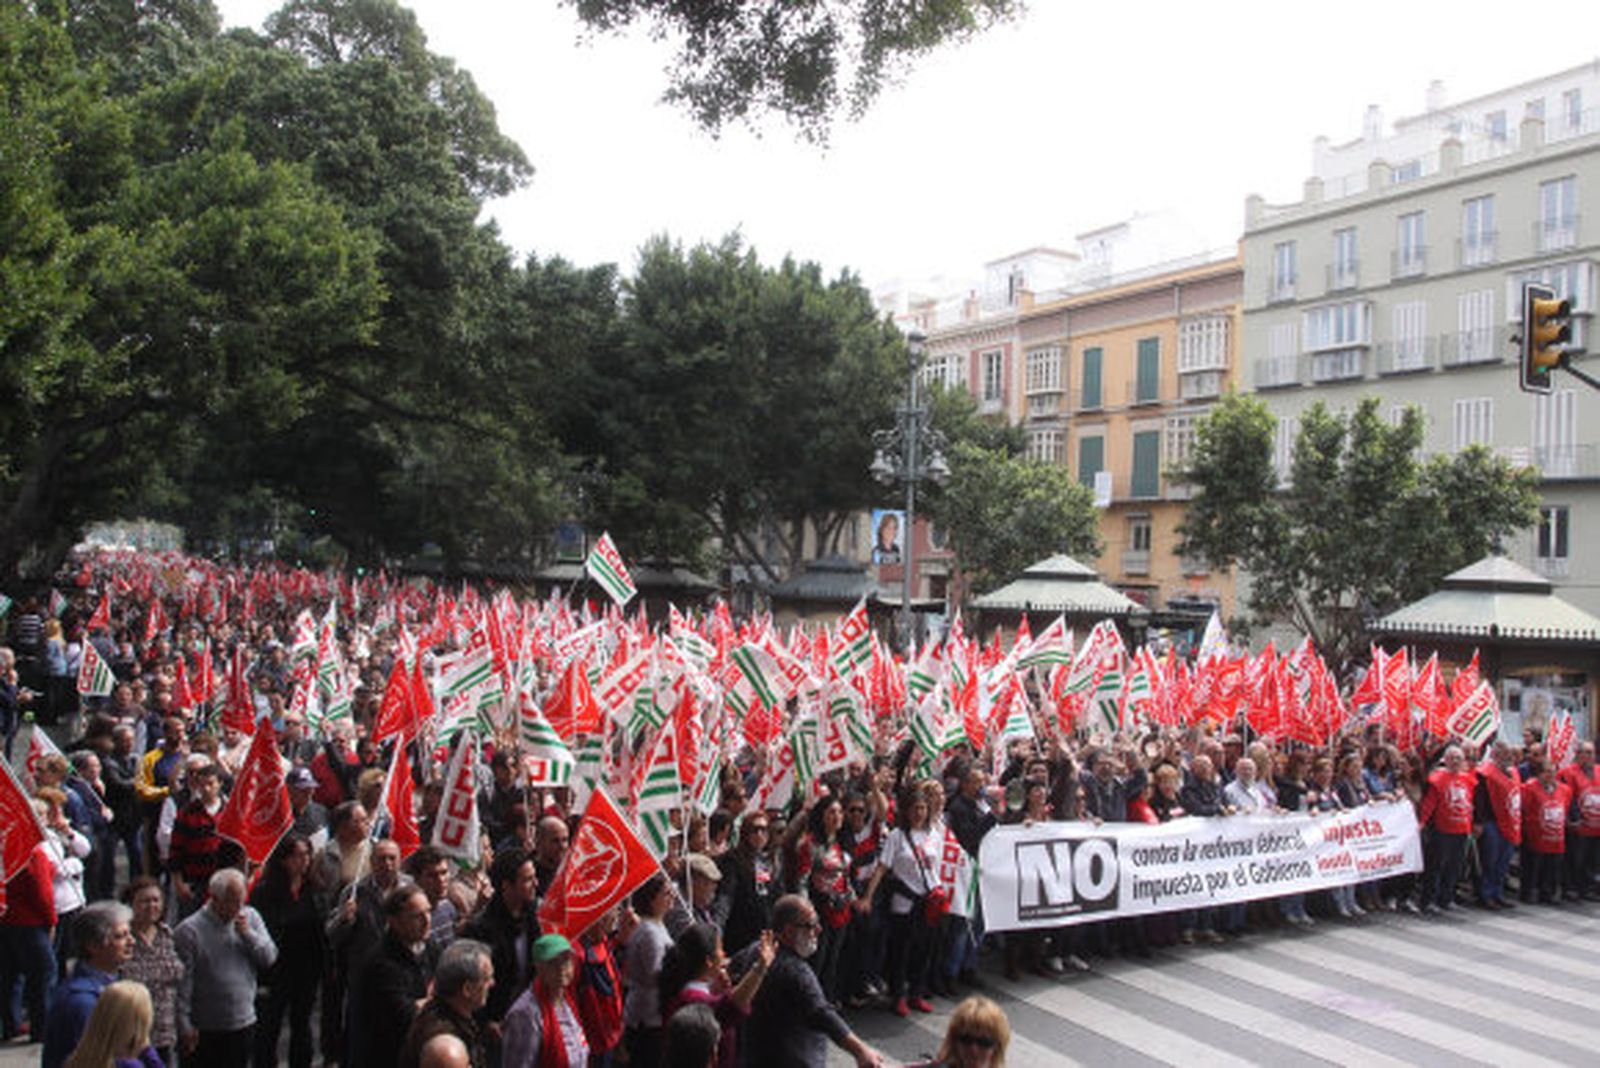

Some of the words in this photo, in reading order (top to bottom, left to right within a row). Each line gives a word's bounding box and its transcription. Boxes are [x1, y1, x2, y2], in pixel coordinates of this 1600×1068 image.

[1018, 837, 1119, 907] NO
[1132, 844, 1179, 867] contra
[1183, 838, 1196, 862] la
[1200, 835, 1254, 859] reforma
[1133, 871, 1203, 905] impuesta
[1205, 872, 1229, 897] por
[1249, 859, 1312, 884] Gobierno
